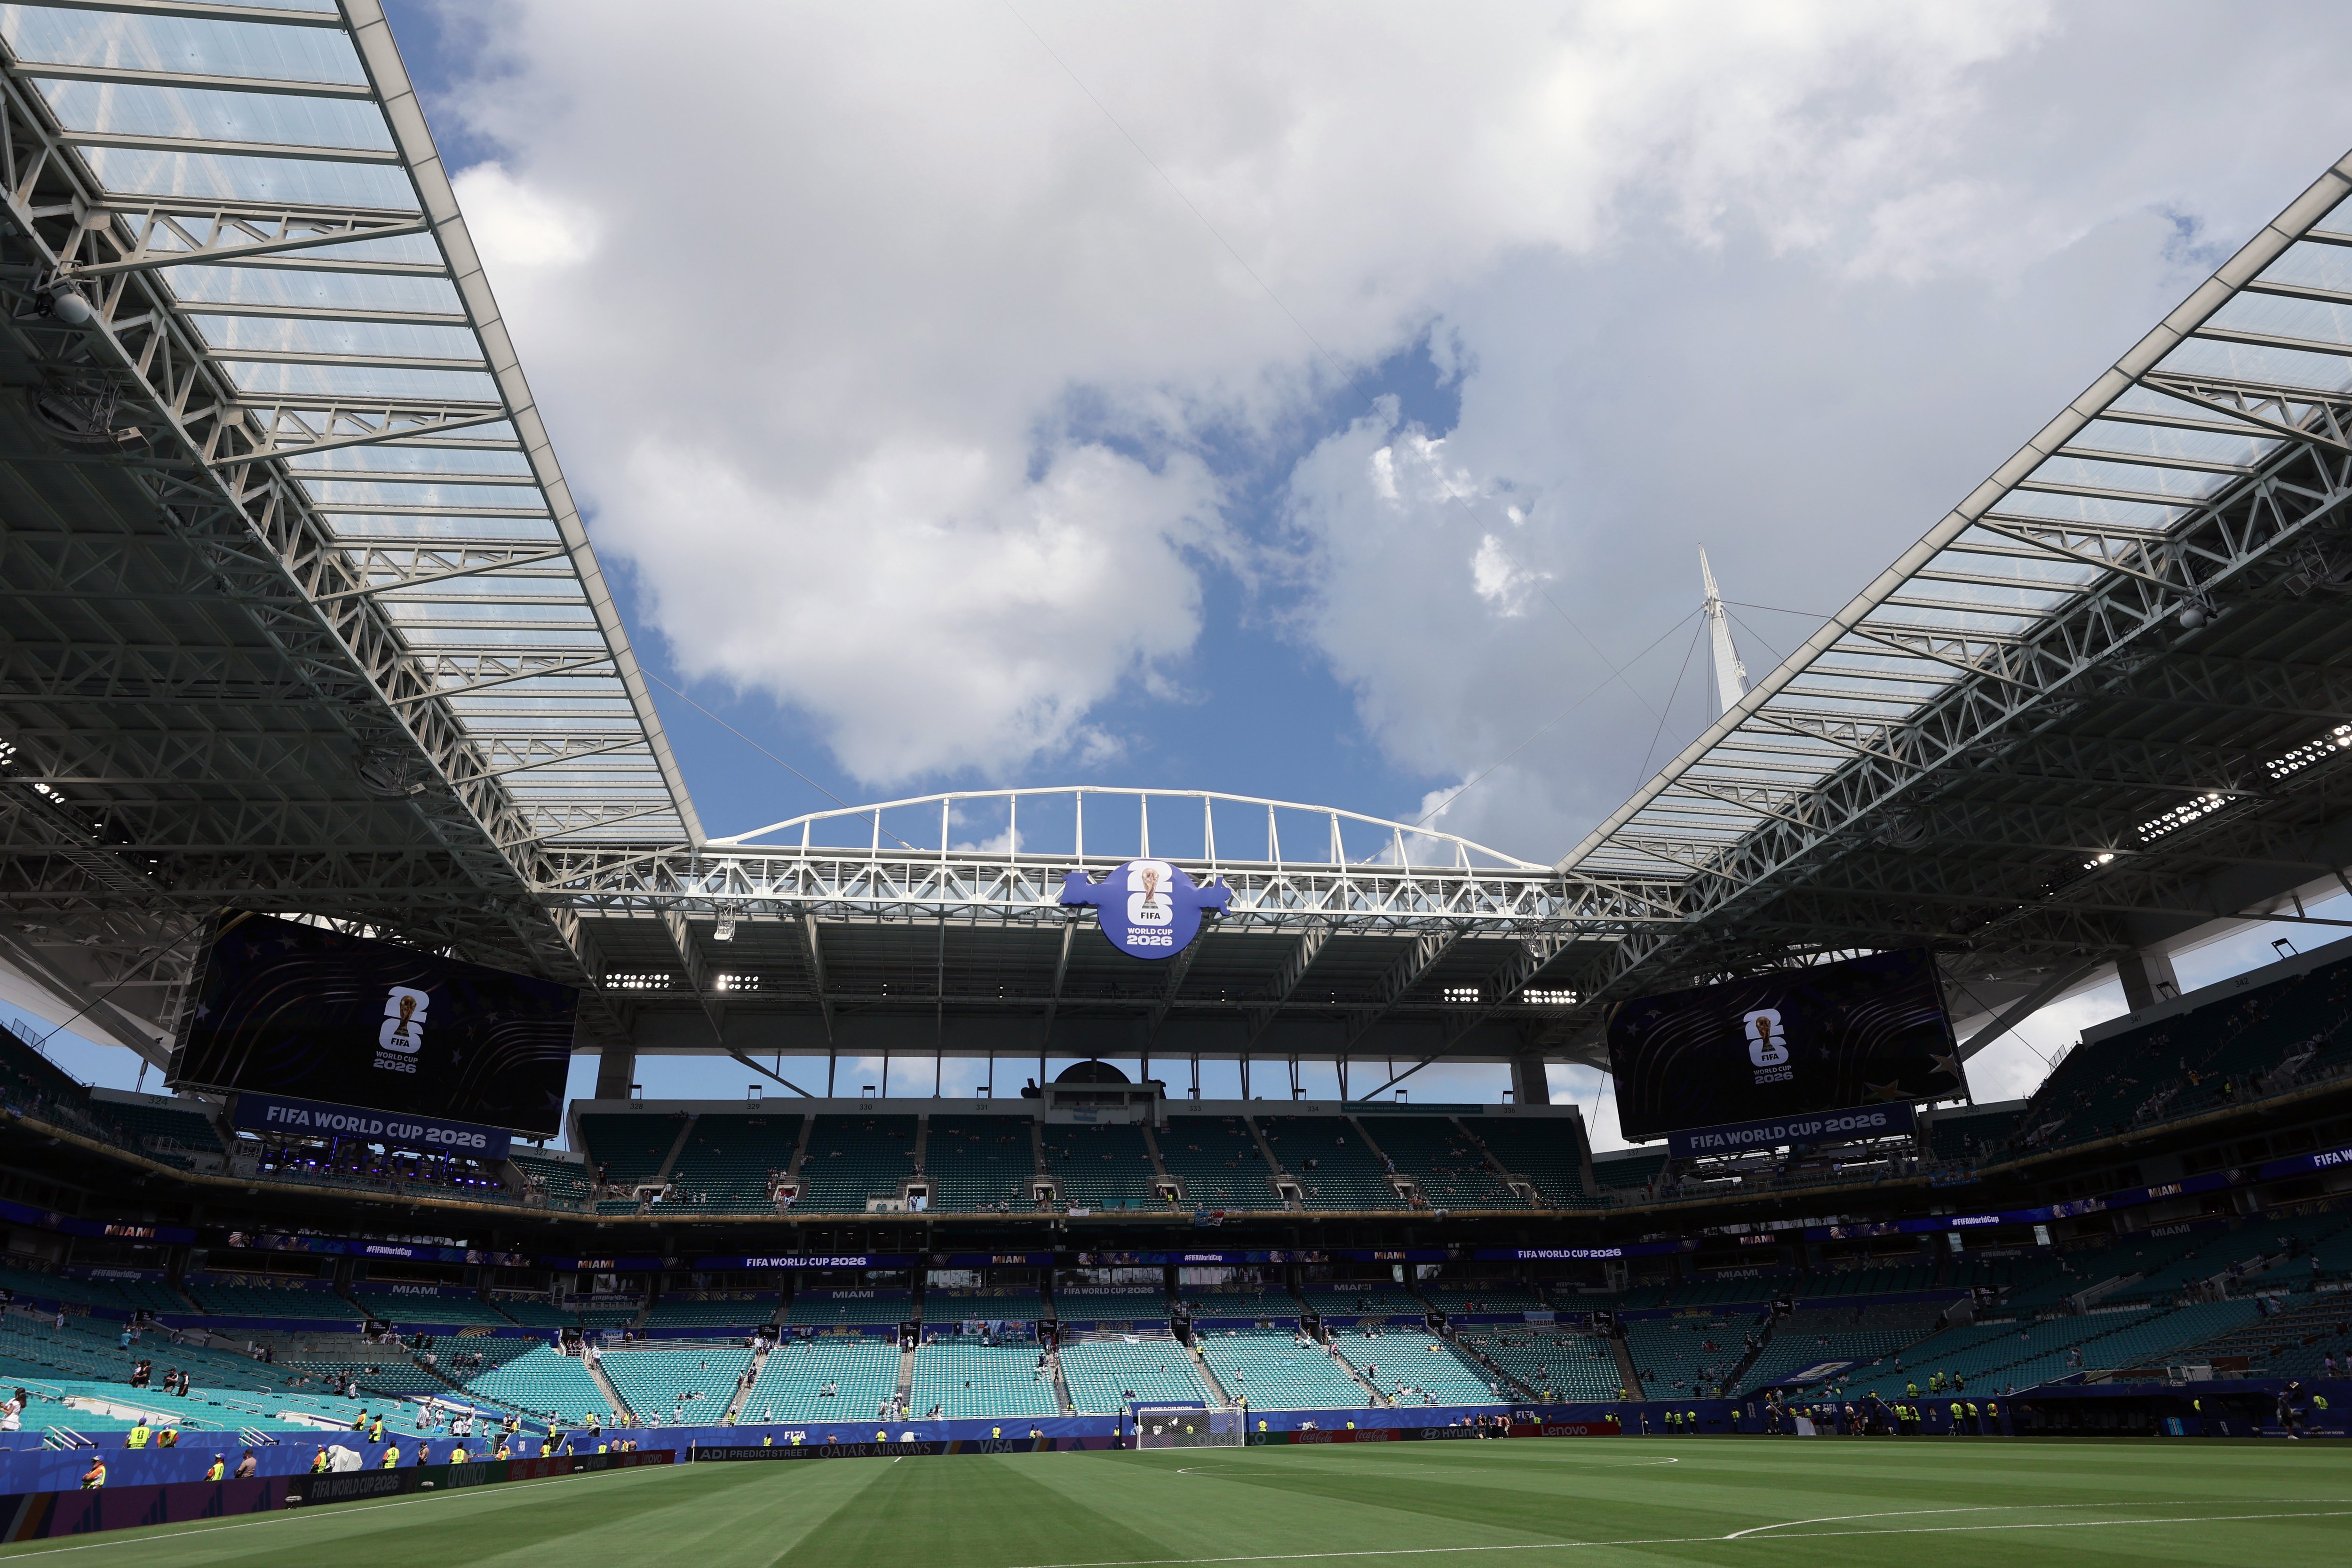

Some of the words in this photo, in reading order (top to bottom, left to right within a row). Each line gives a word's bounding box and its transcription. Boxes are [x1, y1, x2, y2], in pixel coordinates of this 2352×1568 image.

[1127, 935, 1173, 946] 2026
[2235, 978, 2249, 987] 342
[2130, 1015, 2142, 1024] 341
[391, 1037, 410, 1047] FIFA
[376, 1051, 403, 1061] WORLD
[373, 1059, 417, 1073] 2026
[1753, 1067, 1778, 1075] WORLD
[1755, 1071, 1794, 1084] 2026
[149, 1096, 168, 1106] 324
[1963, 1106, 1980, 1114] 340
[268, 1106, 310, 1126] FIFA
[315, 1112, 383, 1134] WORLD
[386, 1122, 423, 1139] CUP
[425, 1128, 486, 1148] 2026
[1690, 1133, 1725, 1149] FIFA
[1727, 1126, 1786, 1145] WORLD
[1788, 1122, 1822, 1137] CUP
[1825, 1114, 1887, 1132] 2026
[2313, 1152, 2342, 1166] FIFA
[2148, 1183, 2183, 1198] MIAMI
[1952, 1216, 1999, 1226] #FIFAWorldCup
[104, 1225, 156, 1238] MIAMI
[2151, 1224, 2191, 1237] MIAMI
[1740, 1234, 1775, 1245] MIAMI
[366, 1246, 413, 1257] #FIFAWorldCup
[1538, 1250, 1571, 1258] WORLD
[1572, 1250, 1589, 1258] CUP
[1590, 1248, 1622, 1258] 2026
[578, 1260, 615, 1269] MIAMI
[747, 1258, 769, 1267] FIFA
[770, 1258, 808, 1266] WORLD
[809, 1258, 829, 1266] CUP
[831, 1257, 867, 1266] 2026
[92, 1269, 142, 1280] #FIFAWorldCup
[1717, 1269, 1758, 1279] MIAMI
[392, 1285, 438, 1295] MIAMI
[1516, 1410, 1536, 1419] FIFA
[784, 1431, 806, 1440] FIFA
[1299, 1430, 1333, 1443] Coca-Cola
[1355, 1429, 1389, 1442] Coca-Cola
[1541, 1426, 1588, 1436] Lenovo
[820, 1444, 866, 1458] QATAR
[873, 1442, 931, 1456] AIRWAYS
[977, 1440, 1014, 1454] VISA
[699, 1449, 726, 1459] ADI
[730, 1449, 809, 1458] PREDICTSTREET
[448, 1463, 486, 1488] aramco
[311, 1480, 331, 1498] FIFA
[332, 1478, 358, 1496] WORLD
[359, 1477, 374, 1494] CUP
[373, 1474, 400, 1492] 2026
